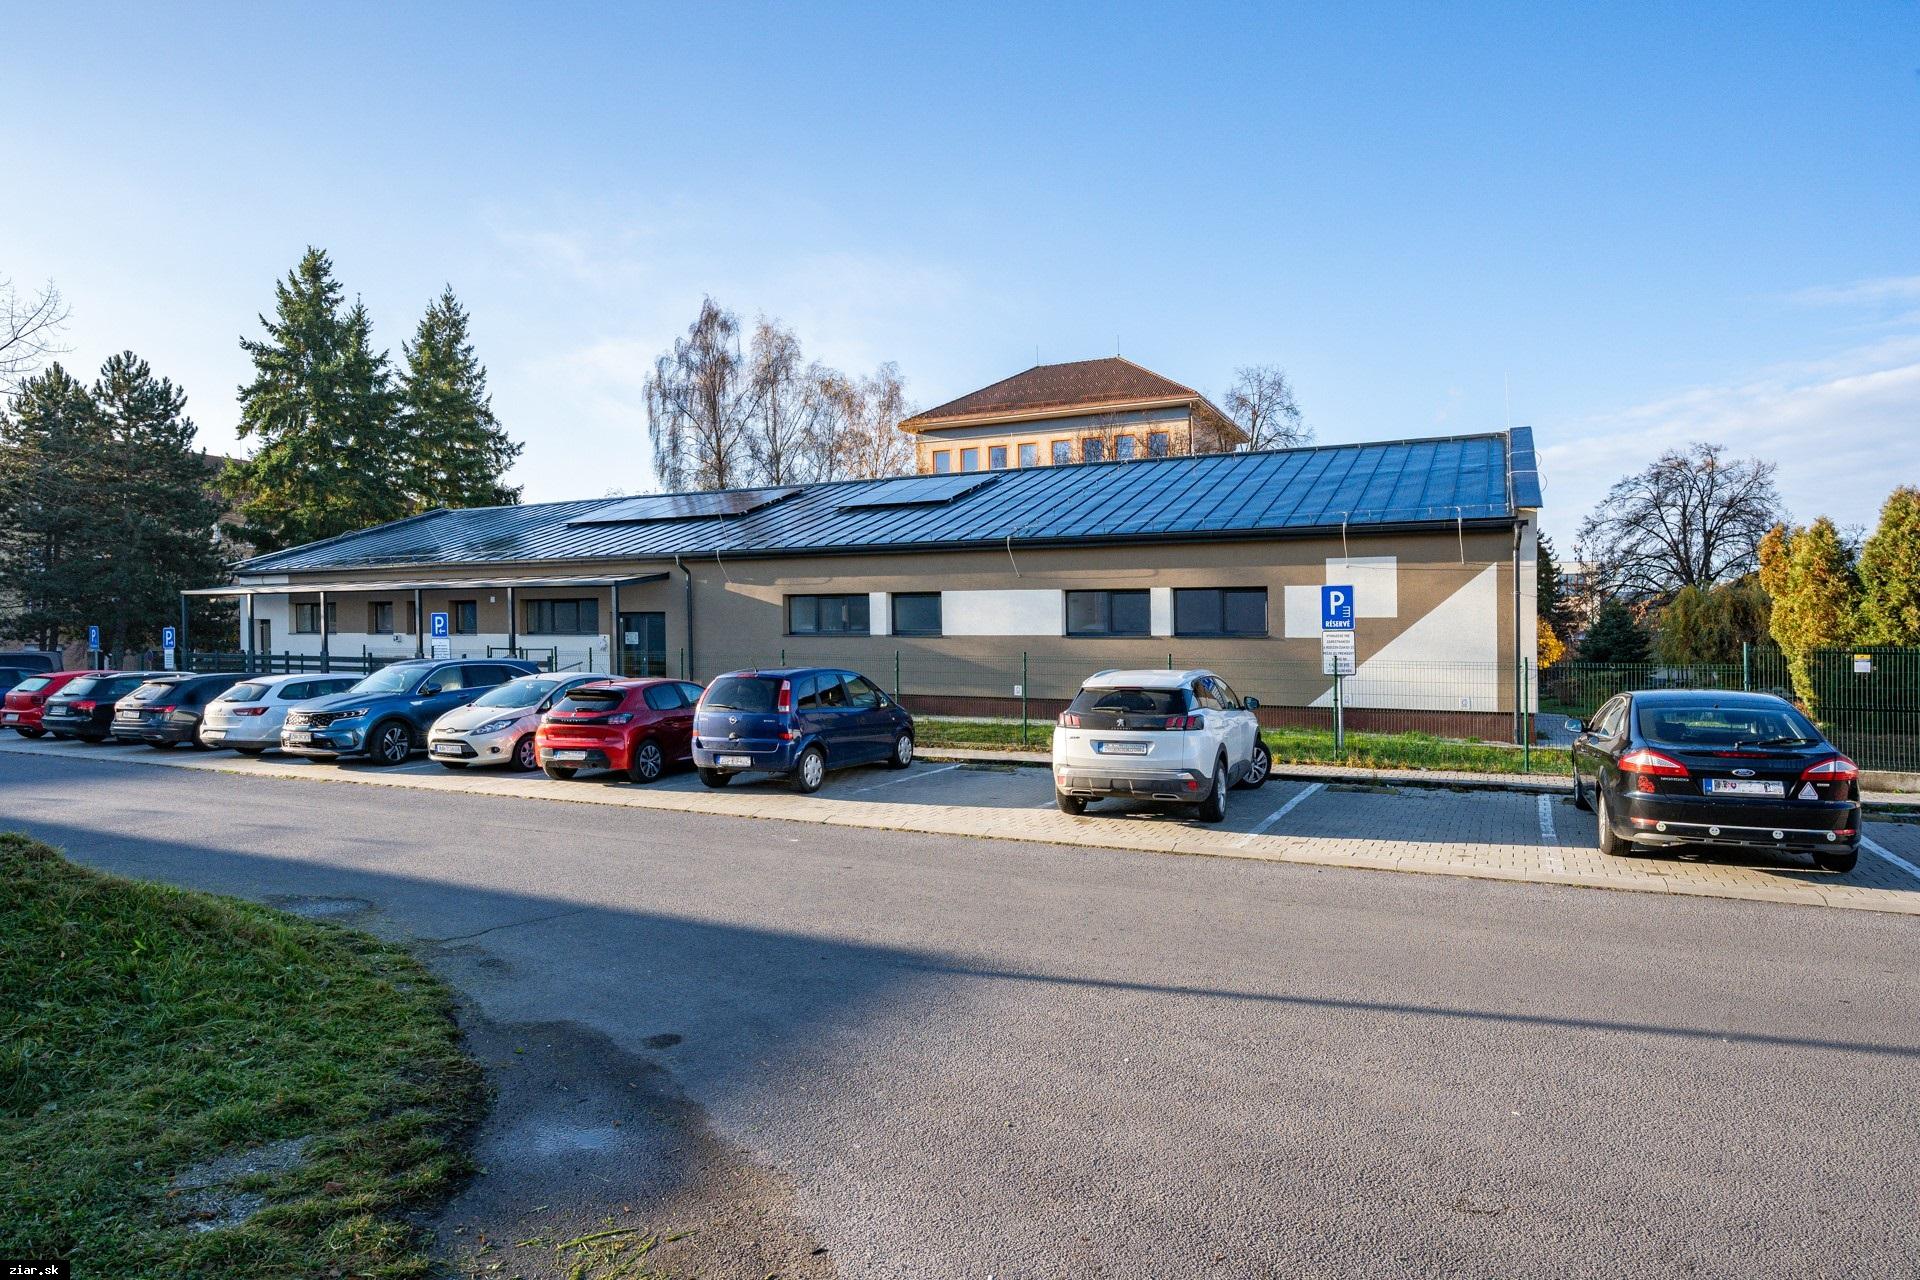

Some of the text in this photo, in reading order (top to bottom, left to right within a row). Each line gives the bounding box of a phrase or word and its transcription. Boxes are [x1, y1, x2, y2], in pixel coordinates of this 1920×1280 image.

[1330, 591, 1344, 615] P
[434, 616, 444, 634] P
[91, 629, 96, 642] P
[165, 631, 173, 646] P
